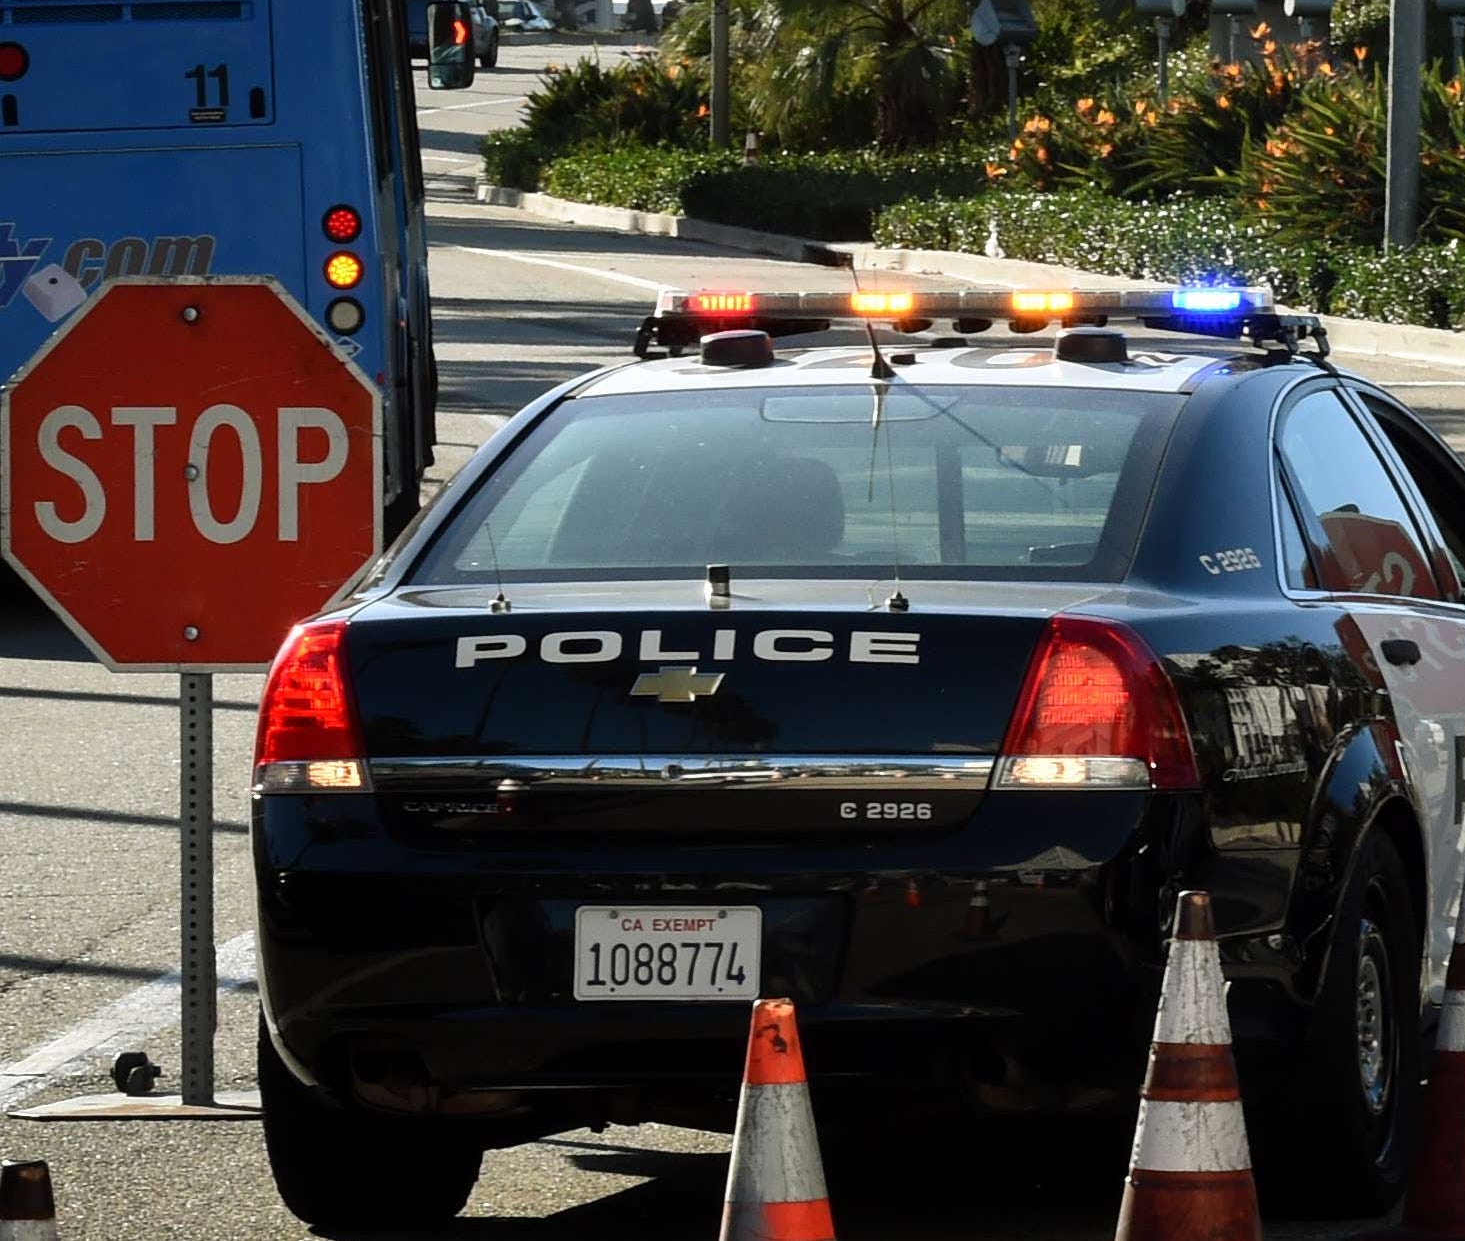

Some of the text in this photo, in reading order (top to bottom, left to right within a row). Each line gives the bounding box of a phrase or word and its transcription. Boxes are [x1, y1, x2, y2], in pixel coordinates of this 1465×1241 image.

[184, 63, 230, 108] 11
[33, 403, 350, 545] STOP
[1198, 554, 1221, 575] C
[454, 628, 921, 669] POLICE
[840, 801, 932, 820] C 2926
[620, 918, 717, 933] CA EXEMPT
[586, 942, 747, 987] 1088774
